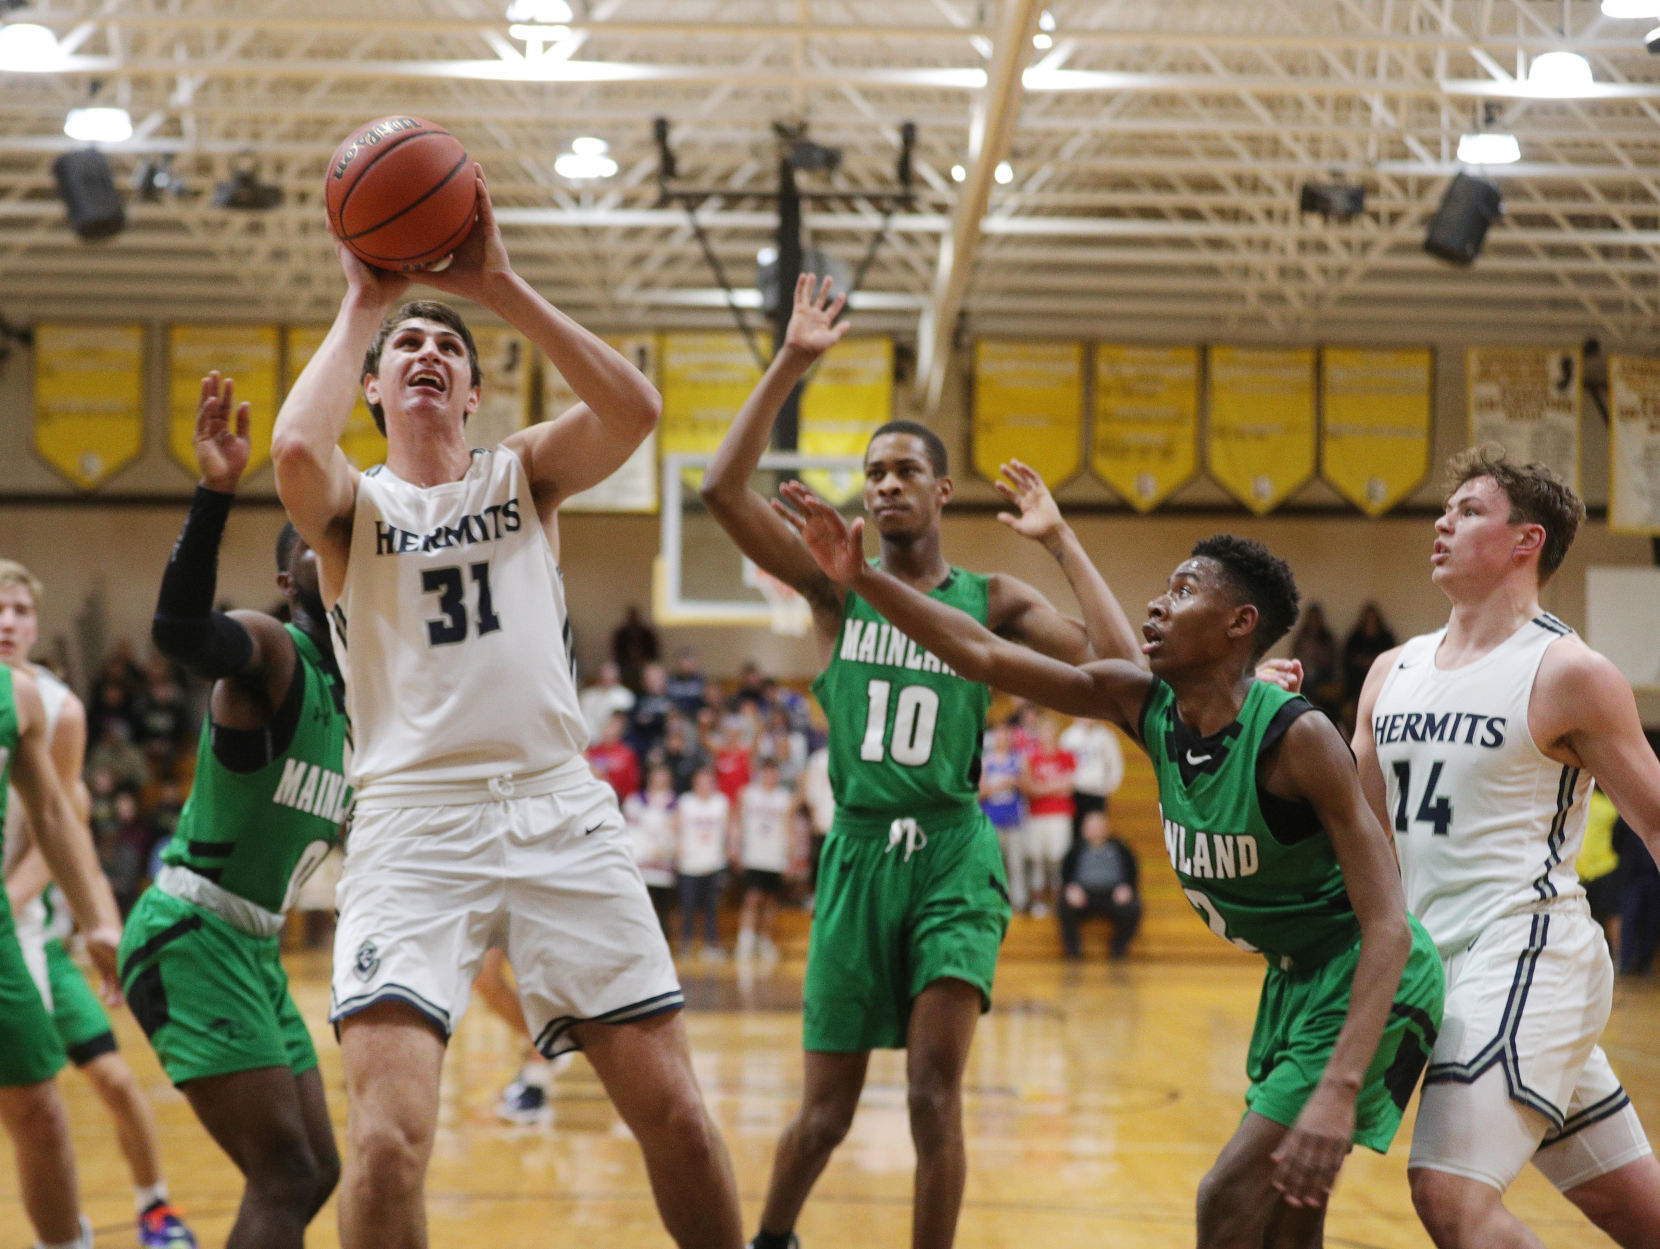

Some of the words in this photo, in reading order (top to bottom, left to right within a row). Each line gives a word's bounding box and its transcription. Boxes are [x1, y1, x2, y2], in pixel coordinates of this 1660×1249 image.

[375, 498, 521, 555] HERMITS
[419, 560, 502, 648] 31
[840, 618, 967, 681] MAINLA
[860, 679, 939, 767] 10
[1375, 712, 1507, 748] HERMITS
[1391, 758, 1454, 837] 14
[1158, 802, 1259, 880] NLAND
